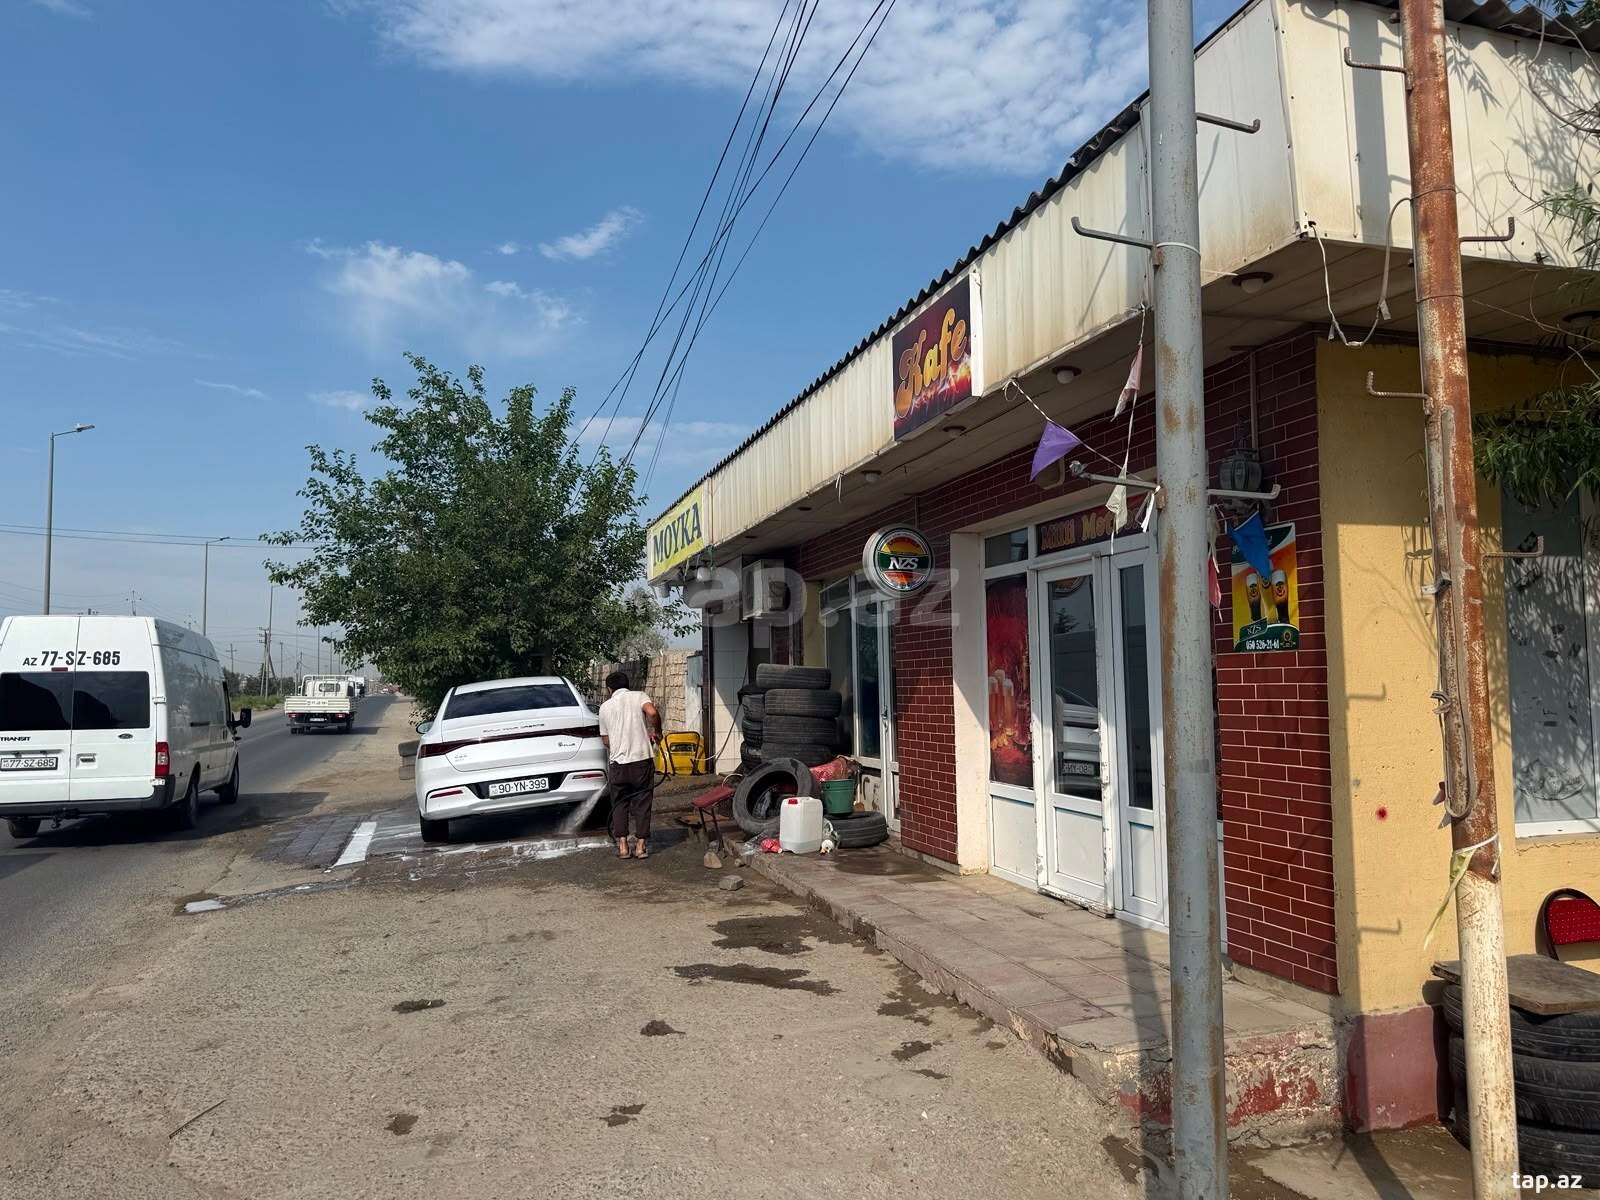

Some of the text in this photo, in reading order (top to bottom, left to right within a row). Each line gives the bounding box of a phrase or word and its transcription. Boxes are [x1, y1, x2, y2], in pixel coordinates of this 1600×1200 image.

[895, 308, 966, 418] Kafe
[653, 502, 702, 566] MOYKA
[888, 556, 919, 570] NZS
[22, 651, 121, 666] AZ 77-SZ-685
[10, 759, 55, 768] 77-SZ-685
[498, 778, 547, 794] 90-YN-399
